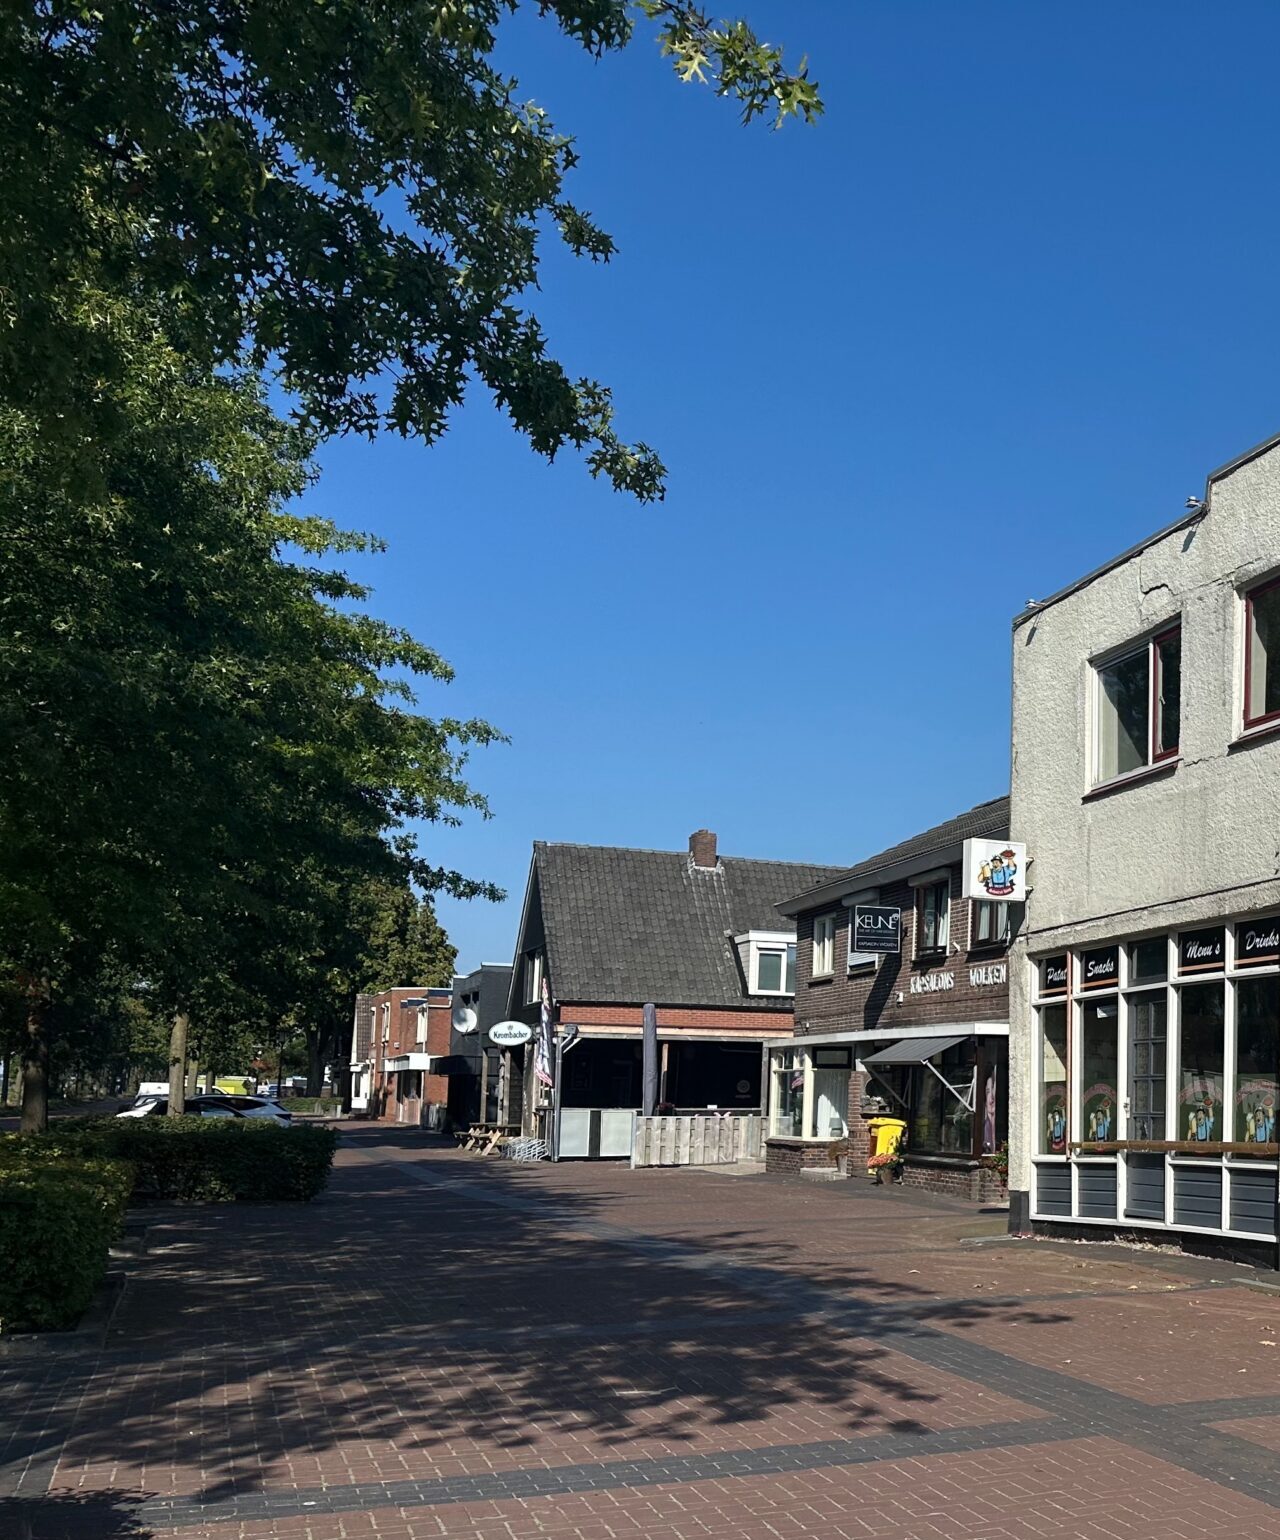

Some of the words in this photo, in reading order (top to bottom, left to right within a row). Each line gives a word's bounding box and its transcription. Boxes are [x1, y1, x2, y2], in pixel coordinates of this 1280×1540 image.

[856, 914, 898, 930] KEUNE
[1186, 937, 1221, 959] Menu's
[1245, 928, 1280, 951] Drinks
[1046, 966, 1068, 984] Patat
[1086, 957, 1114, 977] Snacks
[910, 972, 955, 994] KAPSALONS
[969, 963, 1007, 986] WOLKEN
[493, 1031, 528, 1039] Krombacher
